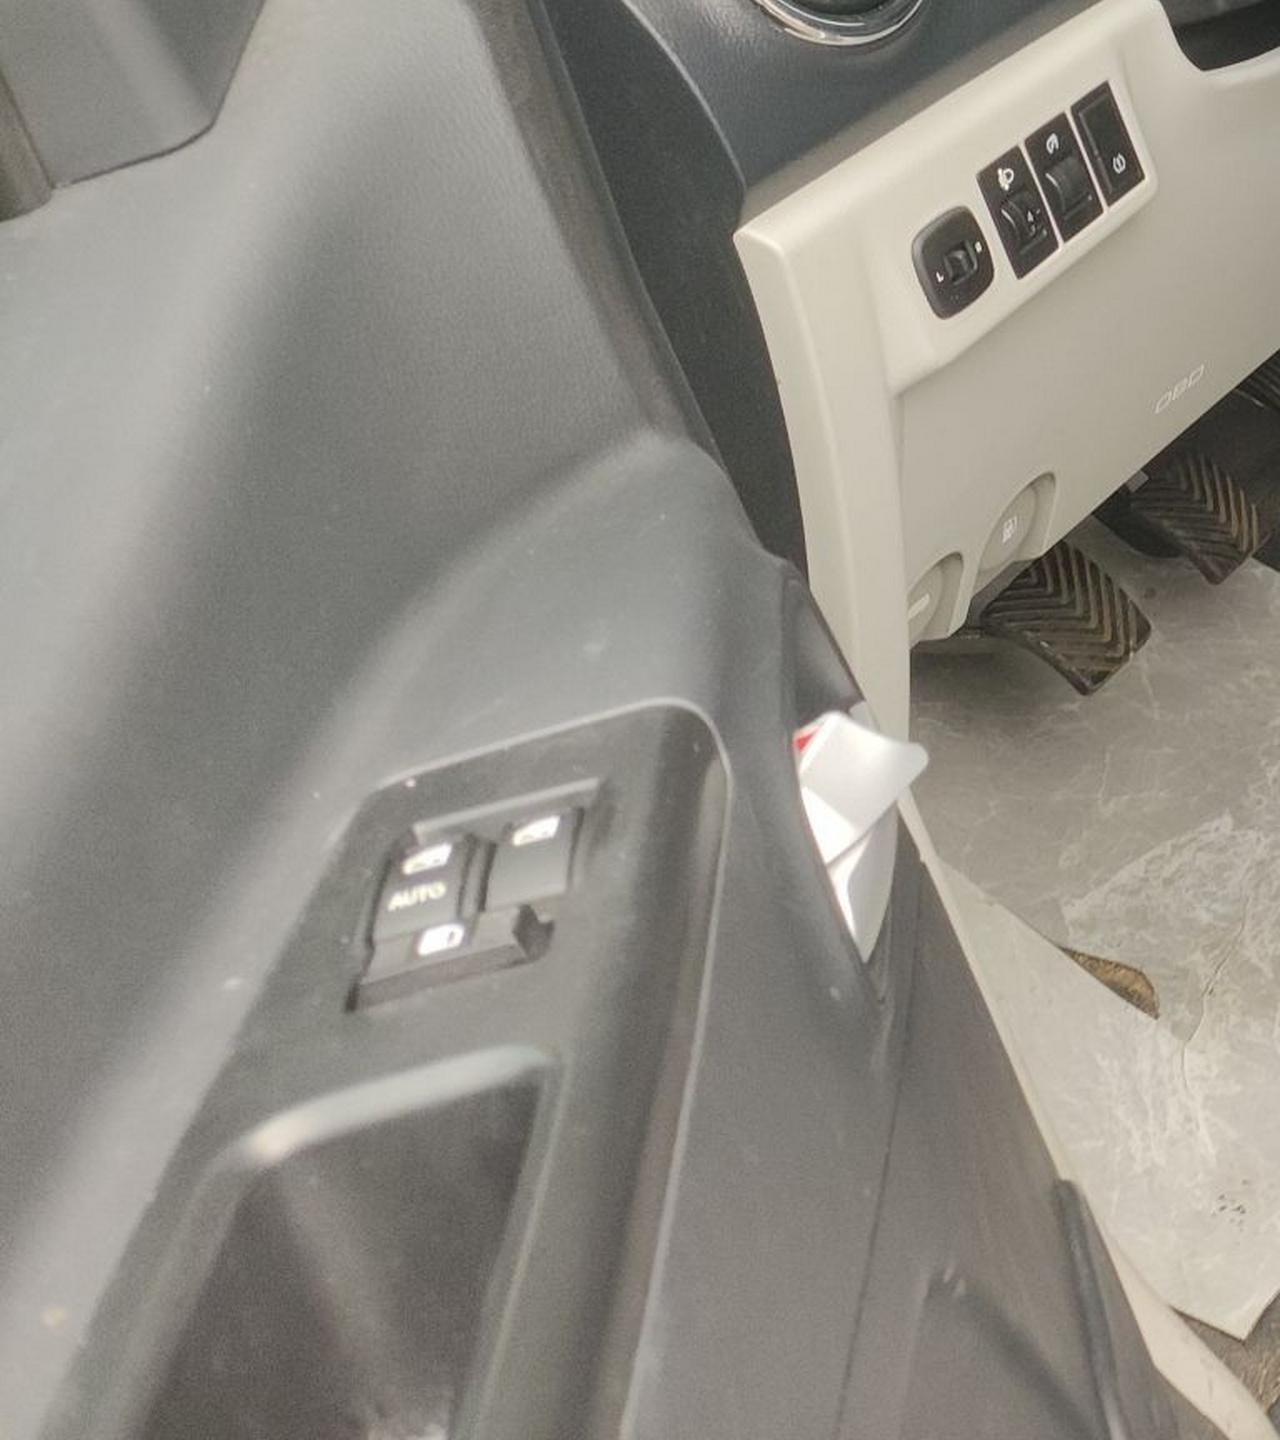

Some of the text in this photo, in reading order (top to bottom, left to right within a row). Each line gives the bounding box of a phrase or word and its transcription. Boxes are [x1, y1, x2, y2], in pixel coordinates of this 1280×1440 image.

[935, 271, 945, 283] L
[1154, 363, 1205, 414] OBD
[387, 880, 448, 913] AUTO
